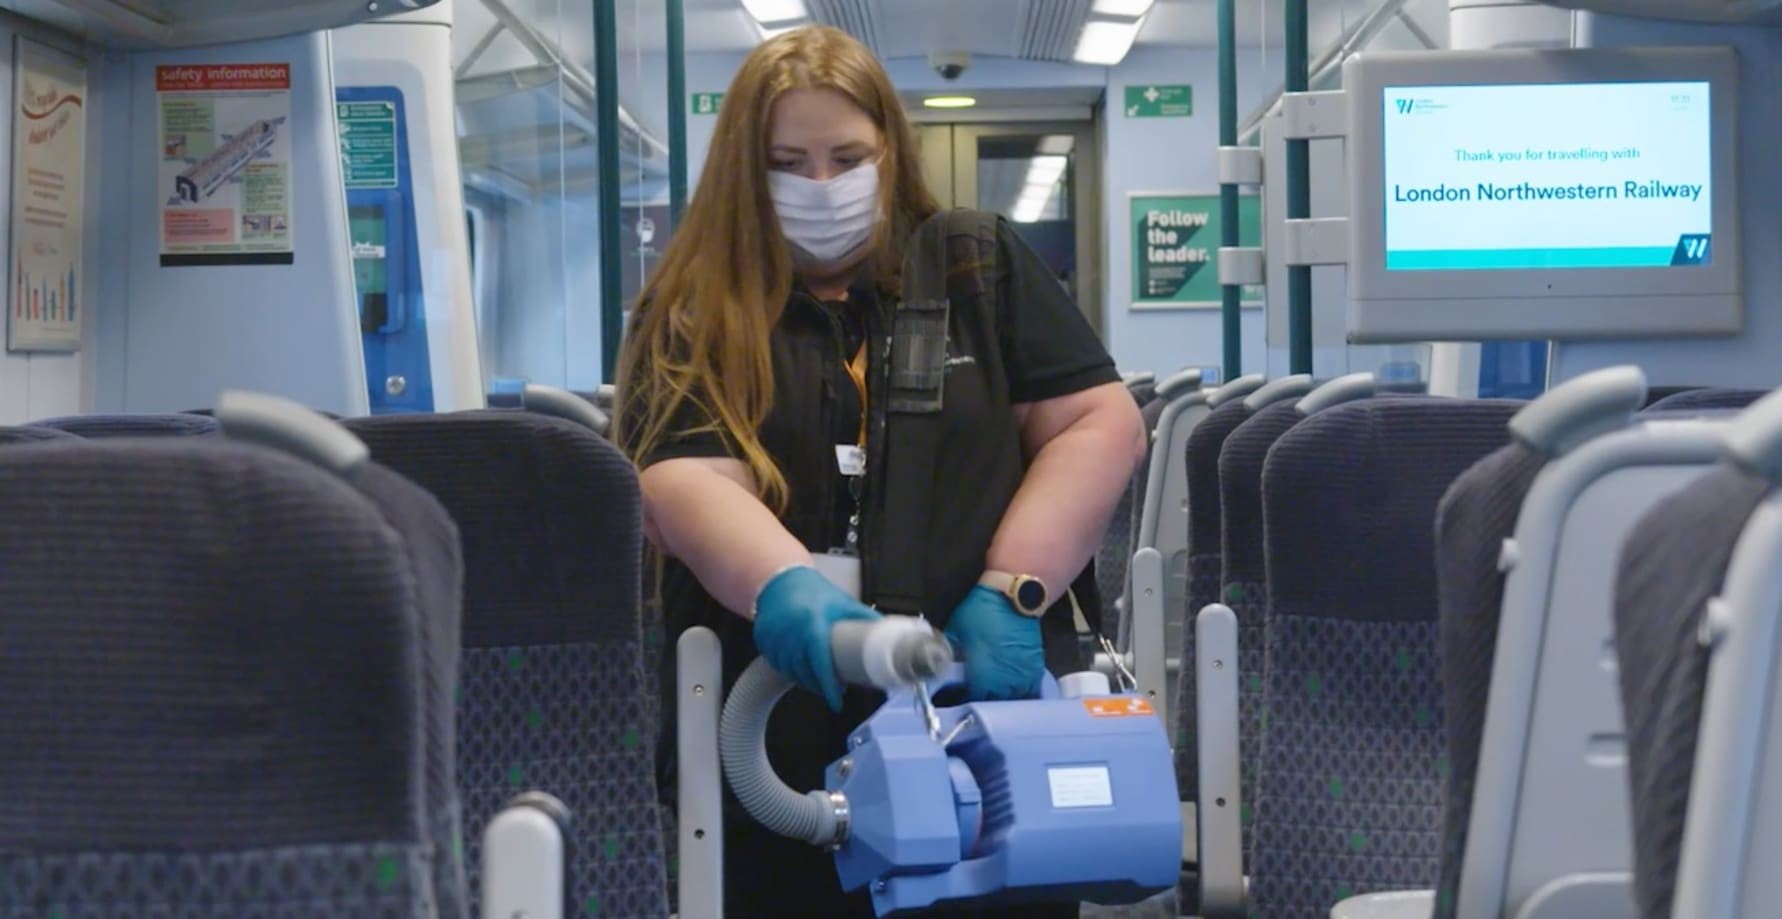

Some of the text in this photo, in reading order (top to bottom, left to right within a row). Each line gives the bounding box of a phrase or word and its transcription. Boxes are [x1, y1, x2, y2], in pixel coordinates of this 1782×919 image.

[161, 65, 287, 83] safety information
[1455, 147, 1641, 163] Thank you for travelling with
[1395, 179, 1703, 202] London Northwestern Railway
[1147, 210, 1209, 227] Follow
[1147, 228, 1178, 245] the
[1147, 246, 1211, 263] leader.
